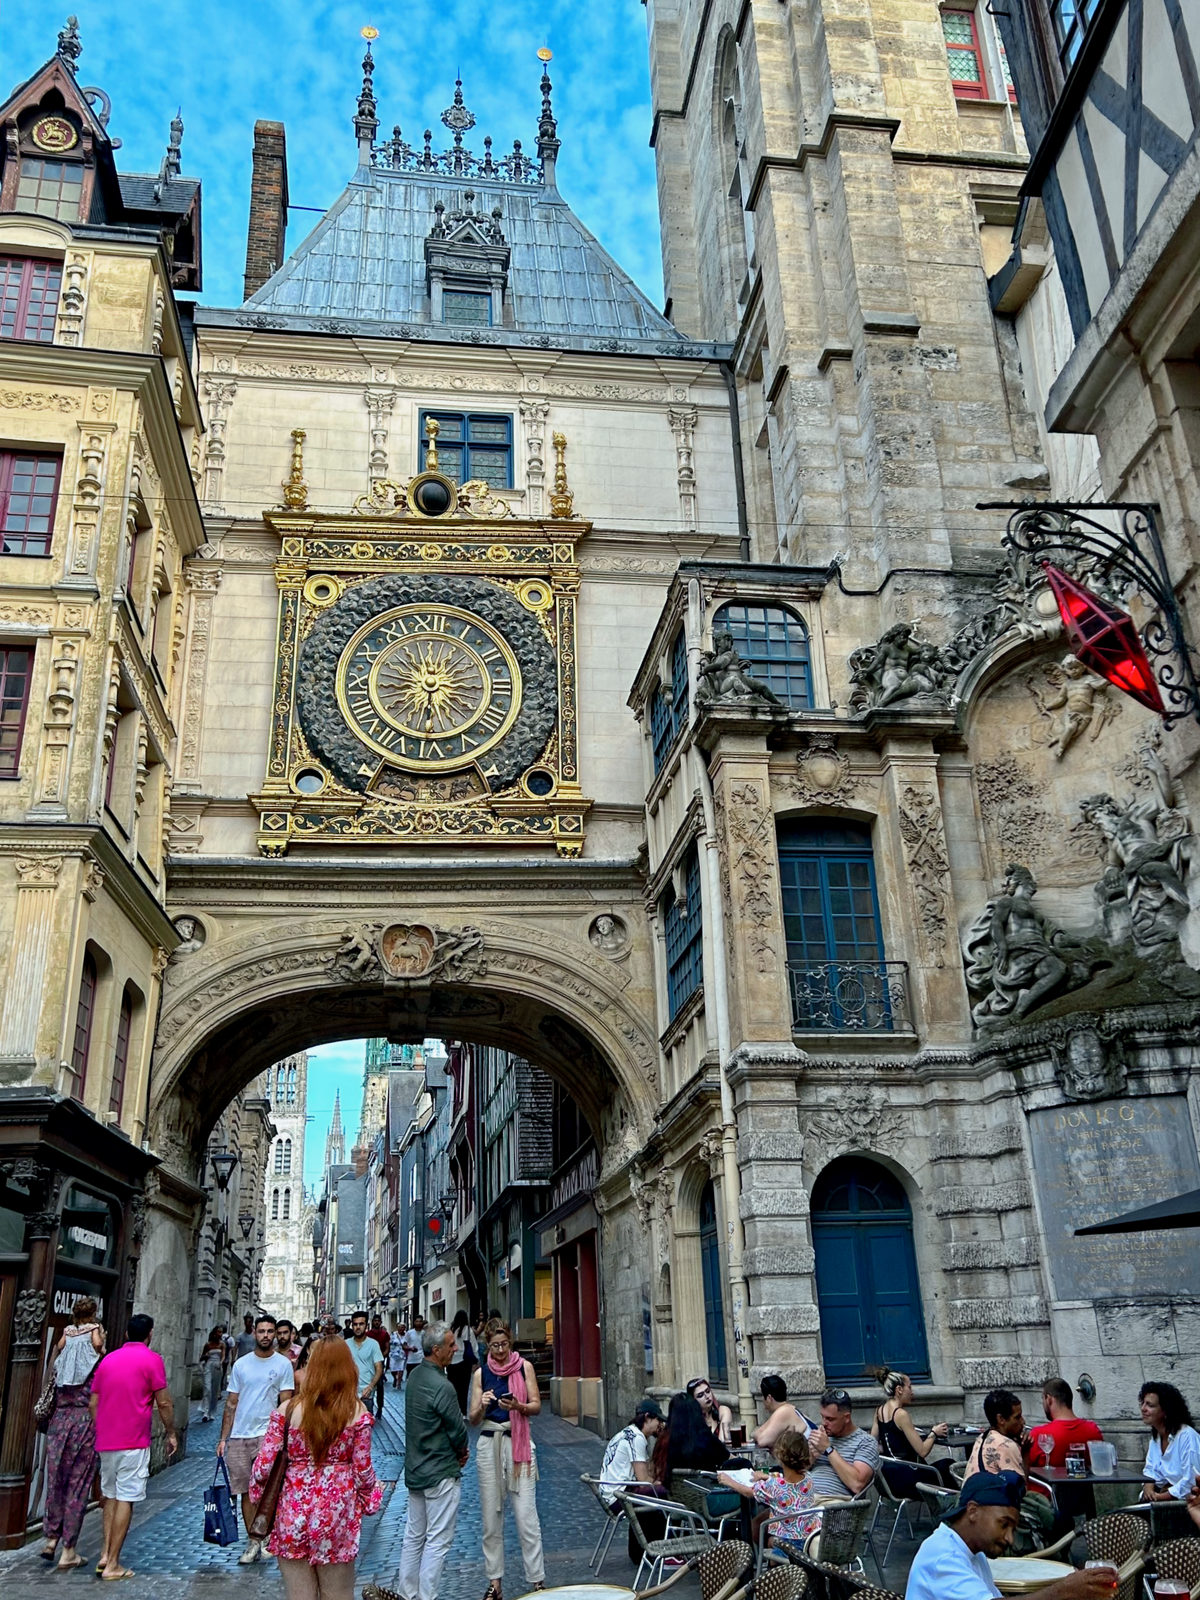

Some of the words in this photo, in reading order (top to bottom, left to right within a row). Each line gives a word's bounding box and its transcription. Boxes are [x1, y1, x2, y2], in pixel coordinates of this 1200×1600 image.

[380, 619, 409, 642] XI
[413, 615, 446, 633] XII
[460, 625, 471, 640] I
[356, 643, 379, 663] X
[482, 647, 502, 663] II
[349, 673, 368, 695] IX
[493, 678, 511, 695] III
[351, 700, 380, 735] VIII
[479, 705, 506, 732] IIII
[376, 730, 406, 755] VII
[419, 740, 445, 759] VI
[460, 733, 479, 752] V
[53, 1290, 104, 1321] CALZA
